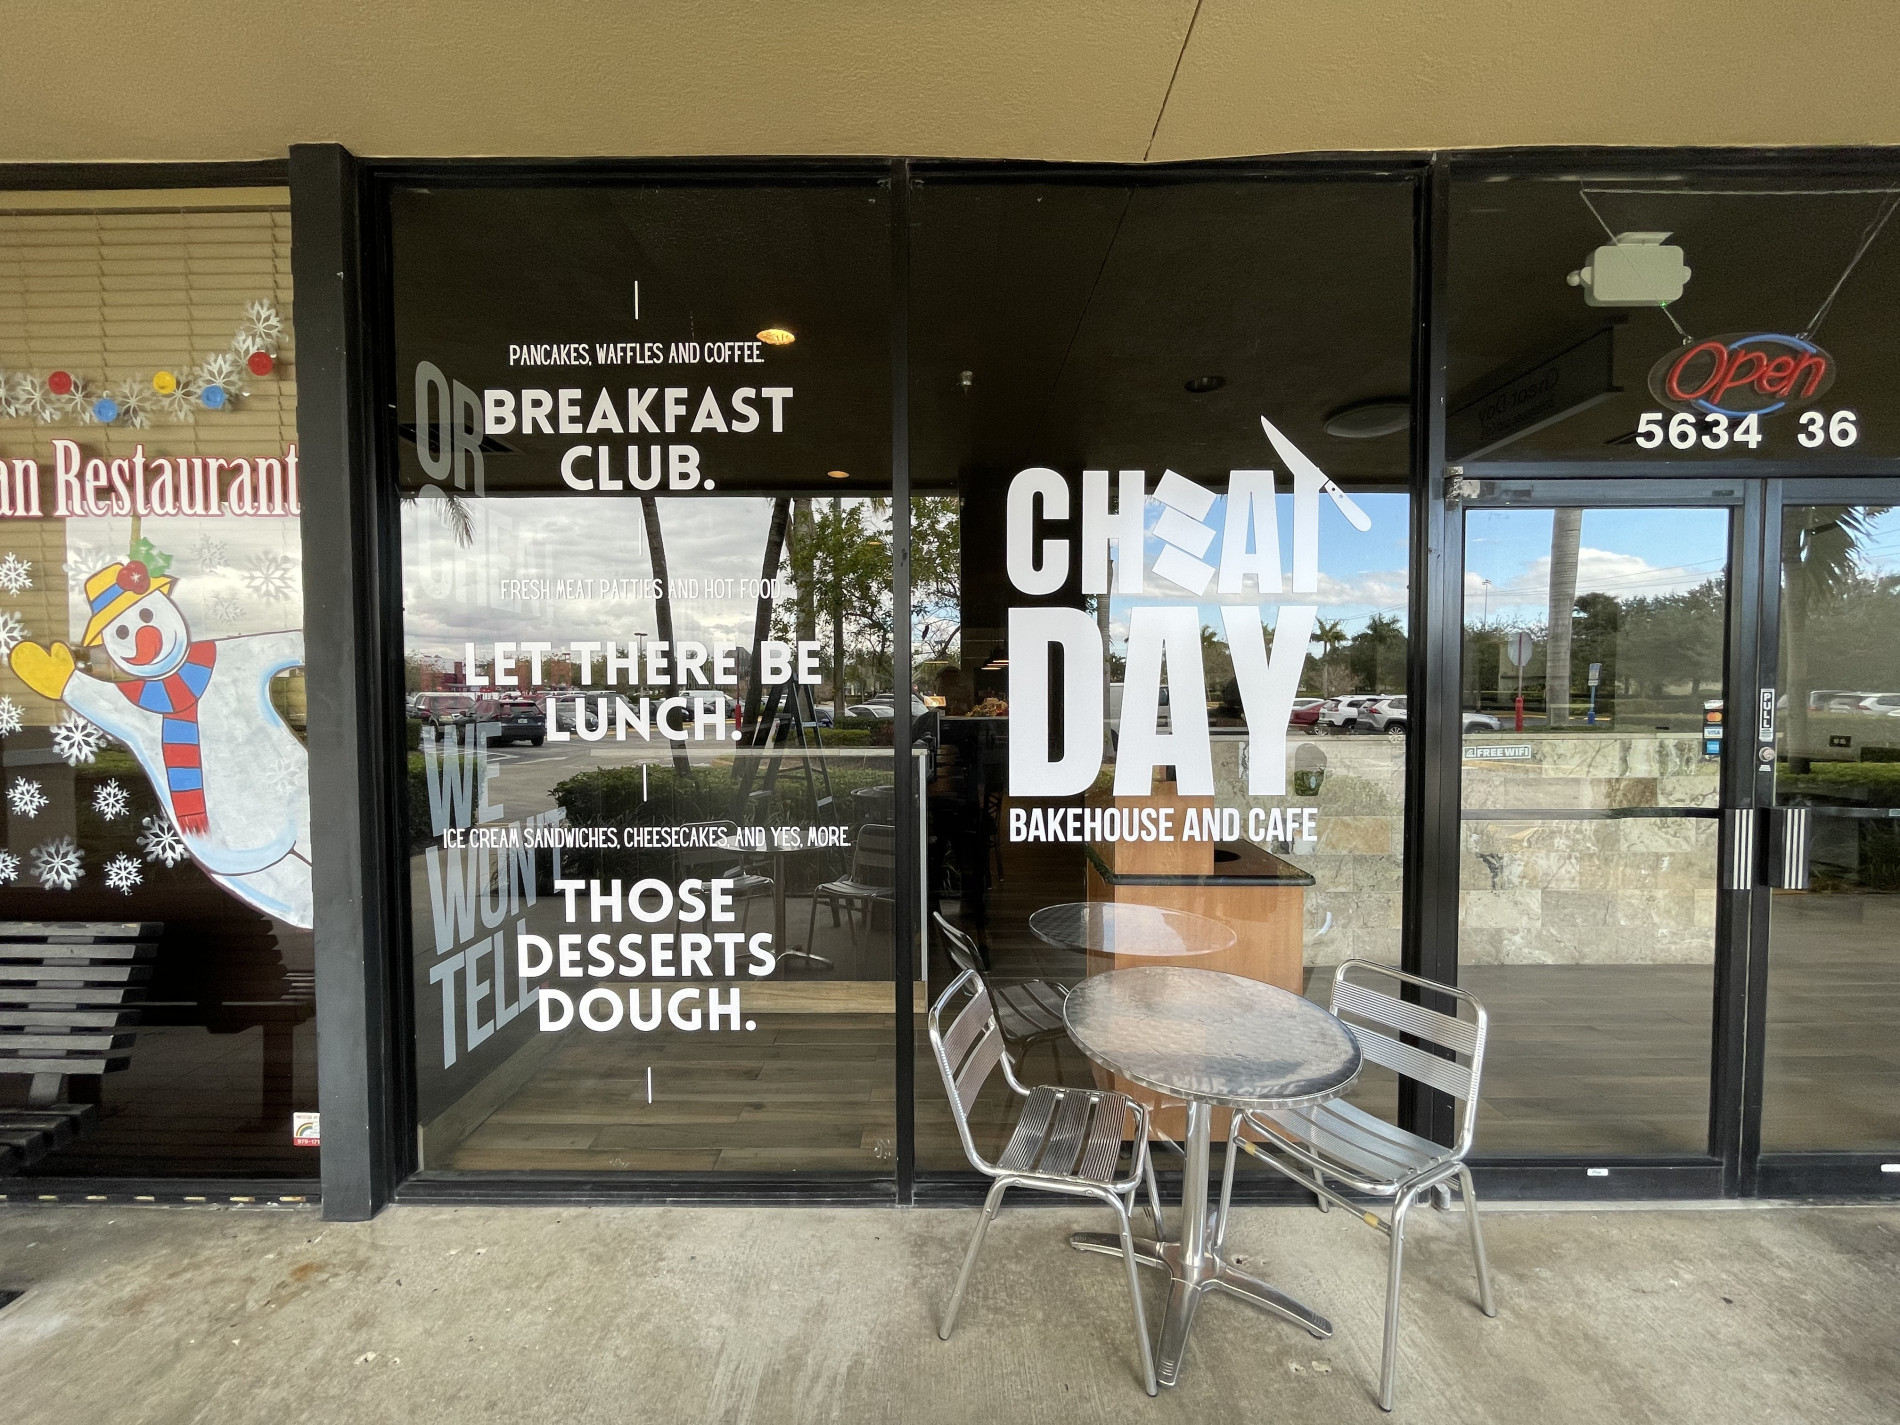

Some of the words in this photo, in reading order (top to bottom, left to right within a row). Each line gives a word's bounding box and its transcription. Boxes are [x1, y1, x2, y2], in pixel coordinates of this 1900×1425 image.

[509, 343, 592, 366] PANCAKES,
[596, 343, 663, 364] WAFFLES
[668, 342, 700, 363] AND
[704, 342, 765, 363] COFFEE.
[1666, 341, 1826, 405] Open
[415, 361, 485, 497] OR
[484, 386, 794, 434] BREAKFAST
[1636, 412, 1762, 449] 5634
[1797, 410, 1858, 448] 36
[51, 439, 300, 517] Restaurant
[560, 444, 716, 491] CLUB.
[1006, 415, 1372, 596] CHEAT
[501, 579, 550, 600] FRESH
[556, 579, 596, 600] MEAT
[601, 579, 663, 599] PATTIES
[668, 579, 700, 598] AND
[705, 578, 735, 598] HOT
[465, 641, 552, 686] LET
[570, 641, 738, 685] THERE
[761, 640, 822, 685] BE
[546, 697, 742, 742] LUNCH.
[1008, 605, 1317, 797] DAY
[1763, 692, 1772, 728] PULL
[1476, 748, 1504, 757] FREE
[422, 722, 504, 837] WE
[442, 828, 466, 849] ICE
[470, 828, 520, 849] CREAM
[523, 828, 621, 849] SANDWICHES,
[624, 826, 730, 849] CHEESECAKES,
[735, 827, 766, 847] AND
[770, 826, 804, 848] YES,
[807, 825, 851, 847] MORE.
[1009, 807, 1174, 842] BAKEHOUSE
[1182, 807, 1240, 842] AND
[1248, 807, 1318, 842] CAFE
[554, 879, 735, 923] THOSE
[517, 932, 776, 978] DESSERTS
[429, 918, 540, 1069] TELL
[538, 987, 757, 1032] DOUGH.
